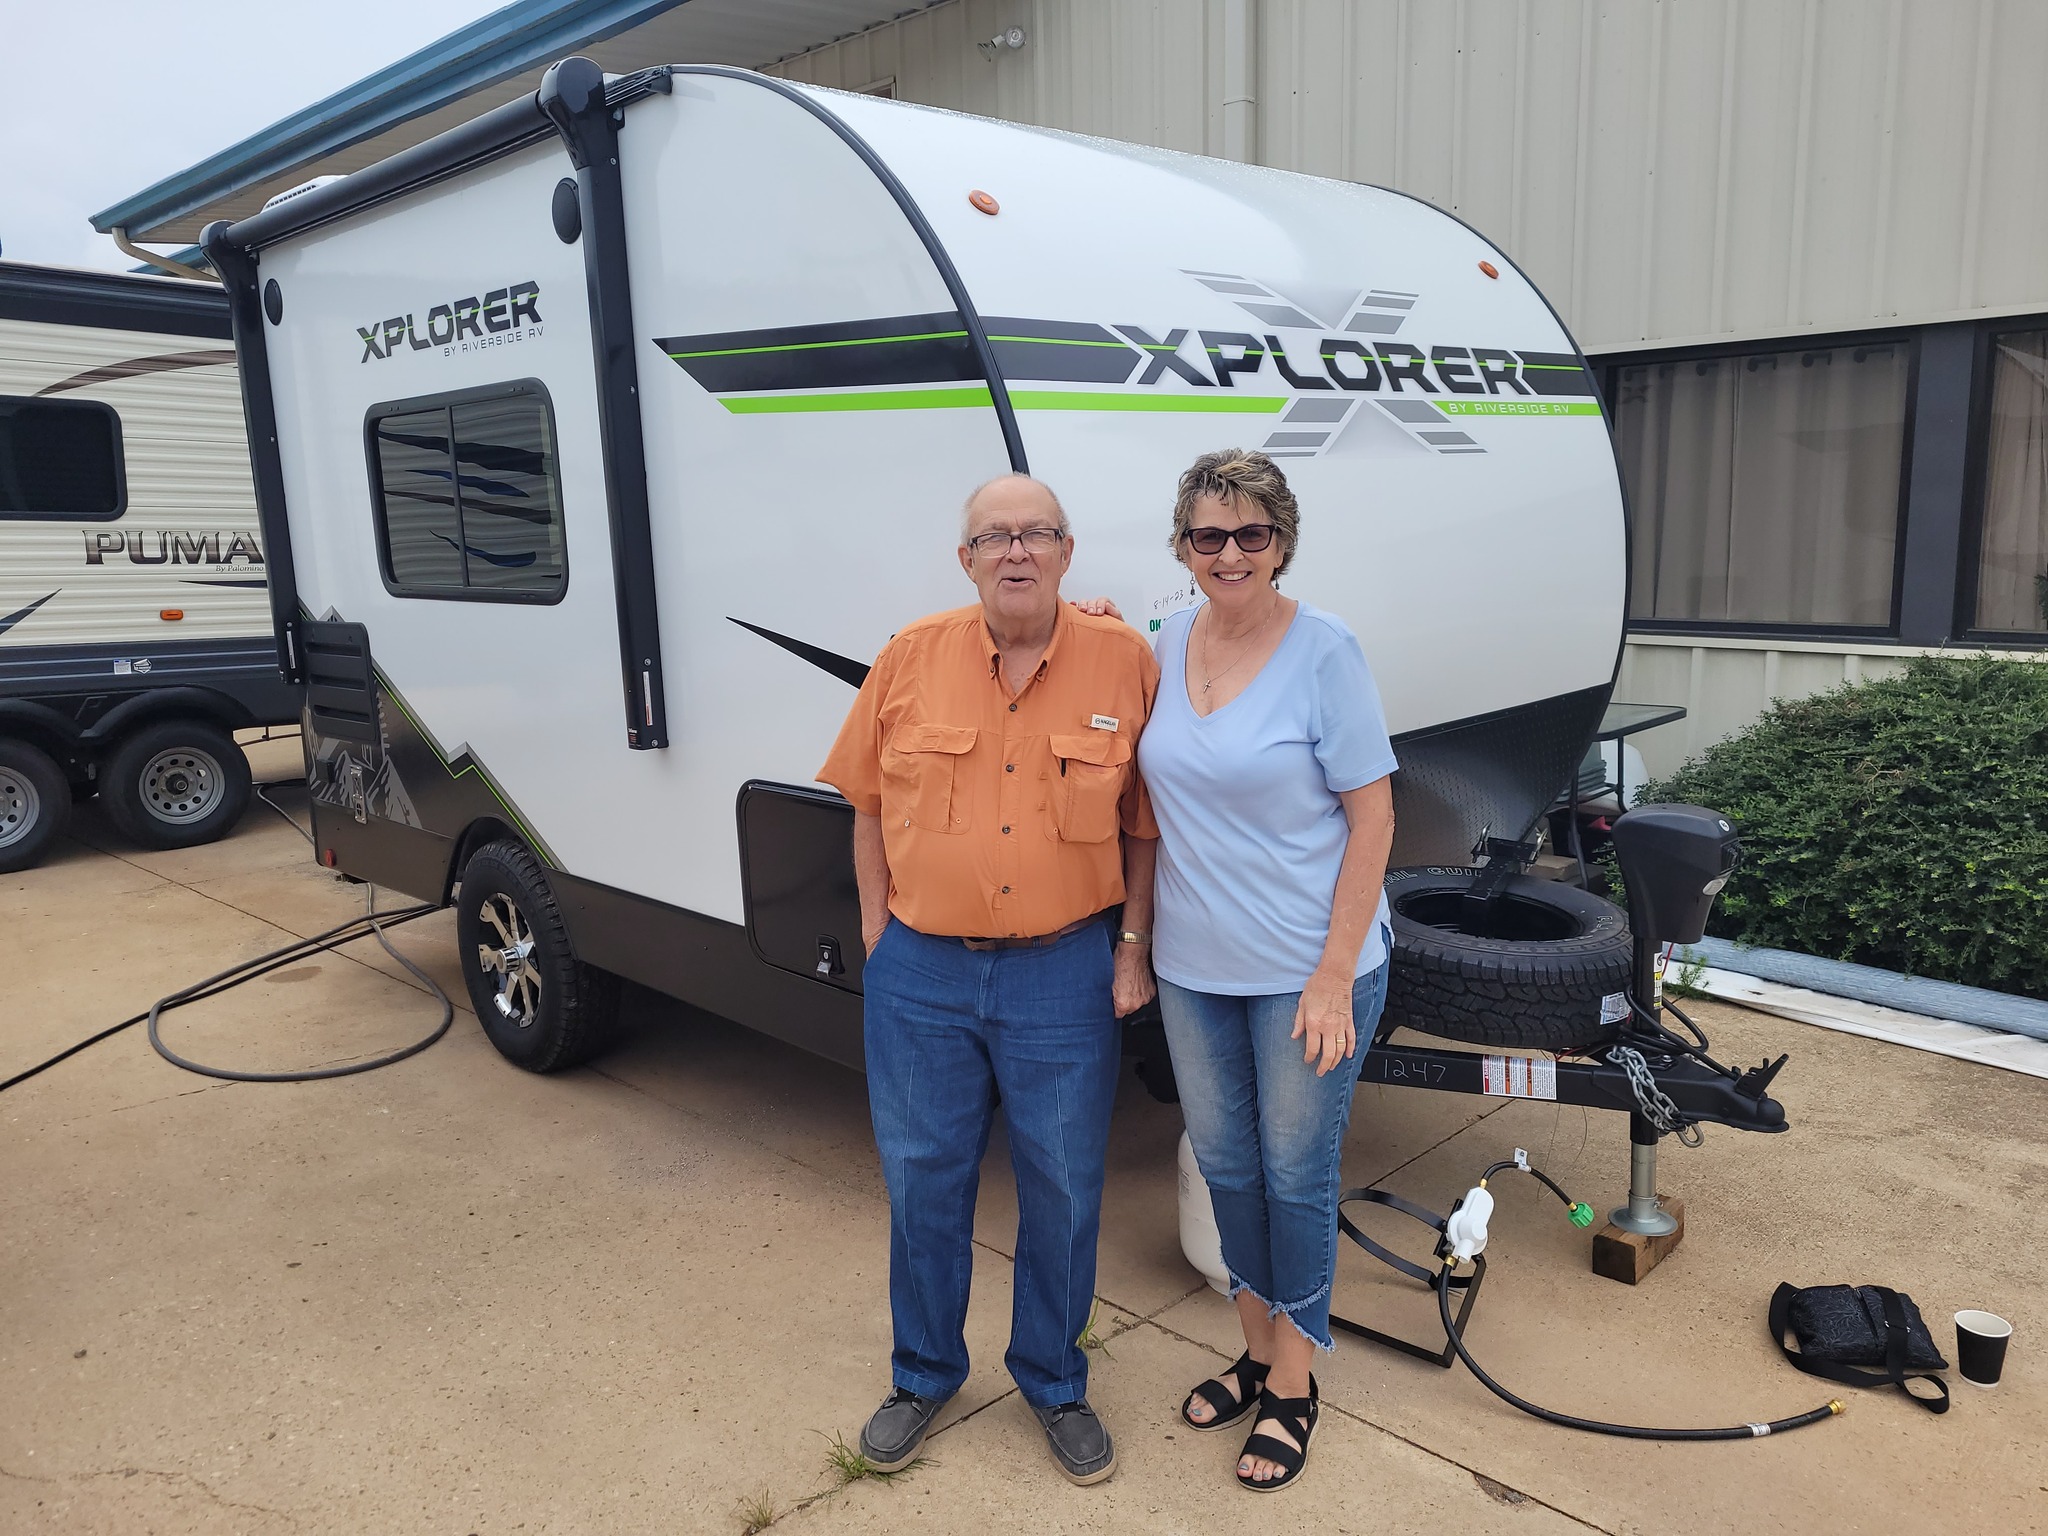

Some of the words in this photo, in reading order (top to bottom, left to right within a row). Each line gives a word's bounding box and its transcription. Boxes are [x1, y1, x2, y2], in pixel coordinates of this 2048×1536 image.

[356, 280, 542, 364] XPLORER
[444, 346, 457, 357] BY
[462, 331, 523, 354] RIVERSIDE
[528, 326, 545, 340] RV
[1109, 324, 1531, 396] XPLORER
[1448, 402, 1466, 413] BY
[1474, 402, 1549, 414] RIVERSIDE
[1553, 404, 1569, 414] RV
[82, 530, 265, 565] PUMA
[1384, 1058, 1447, 1083] 1247
